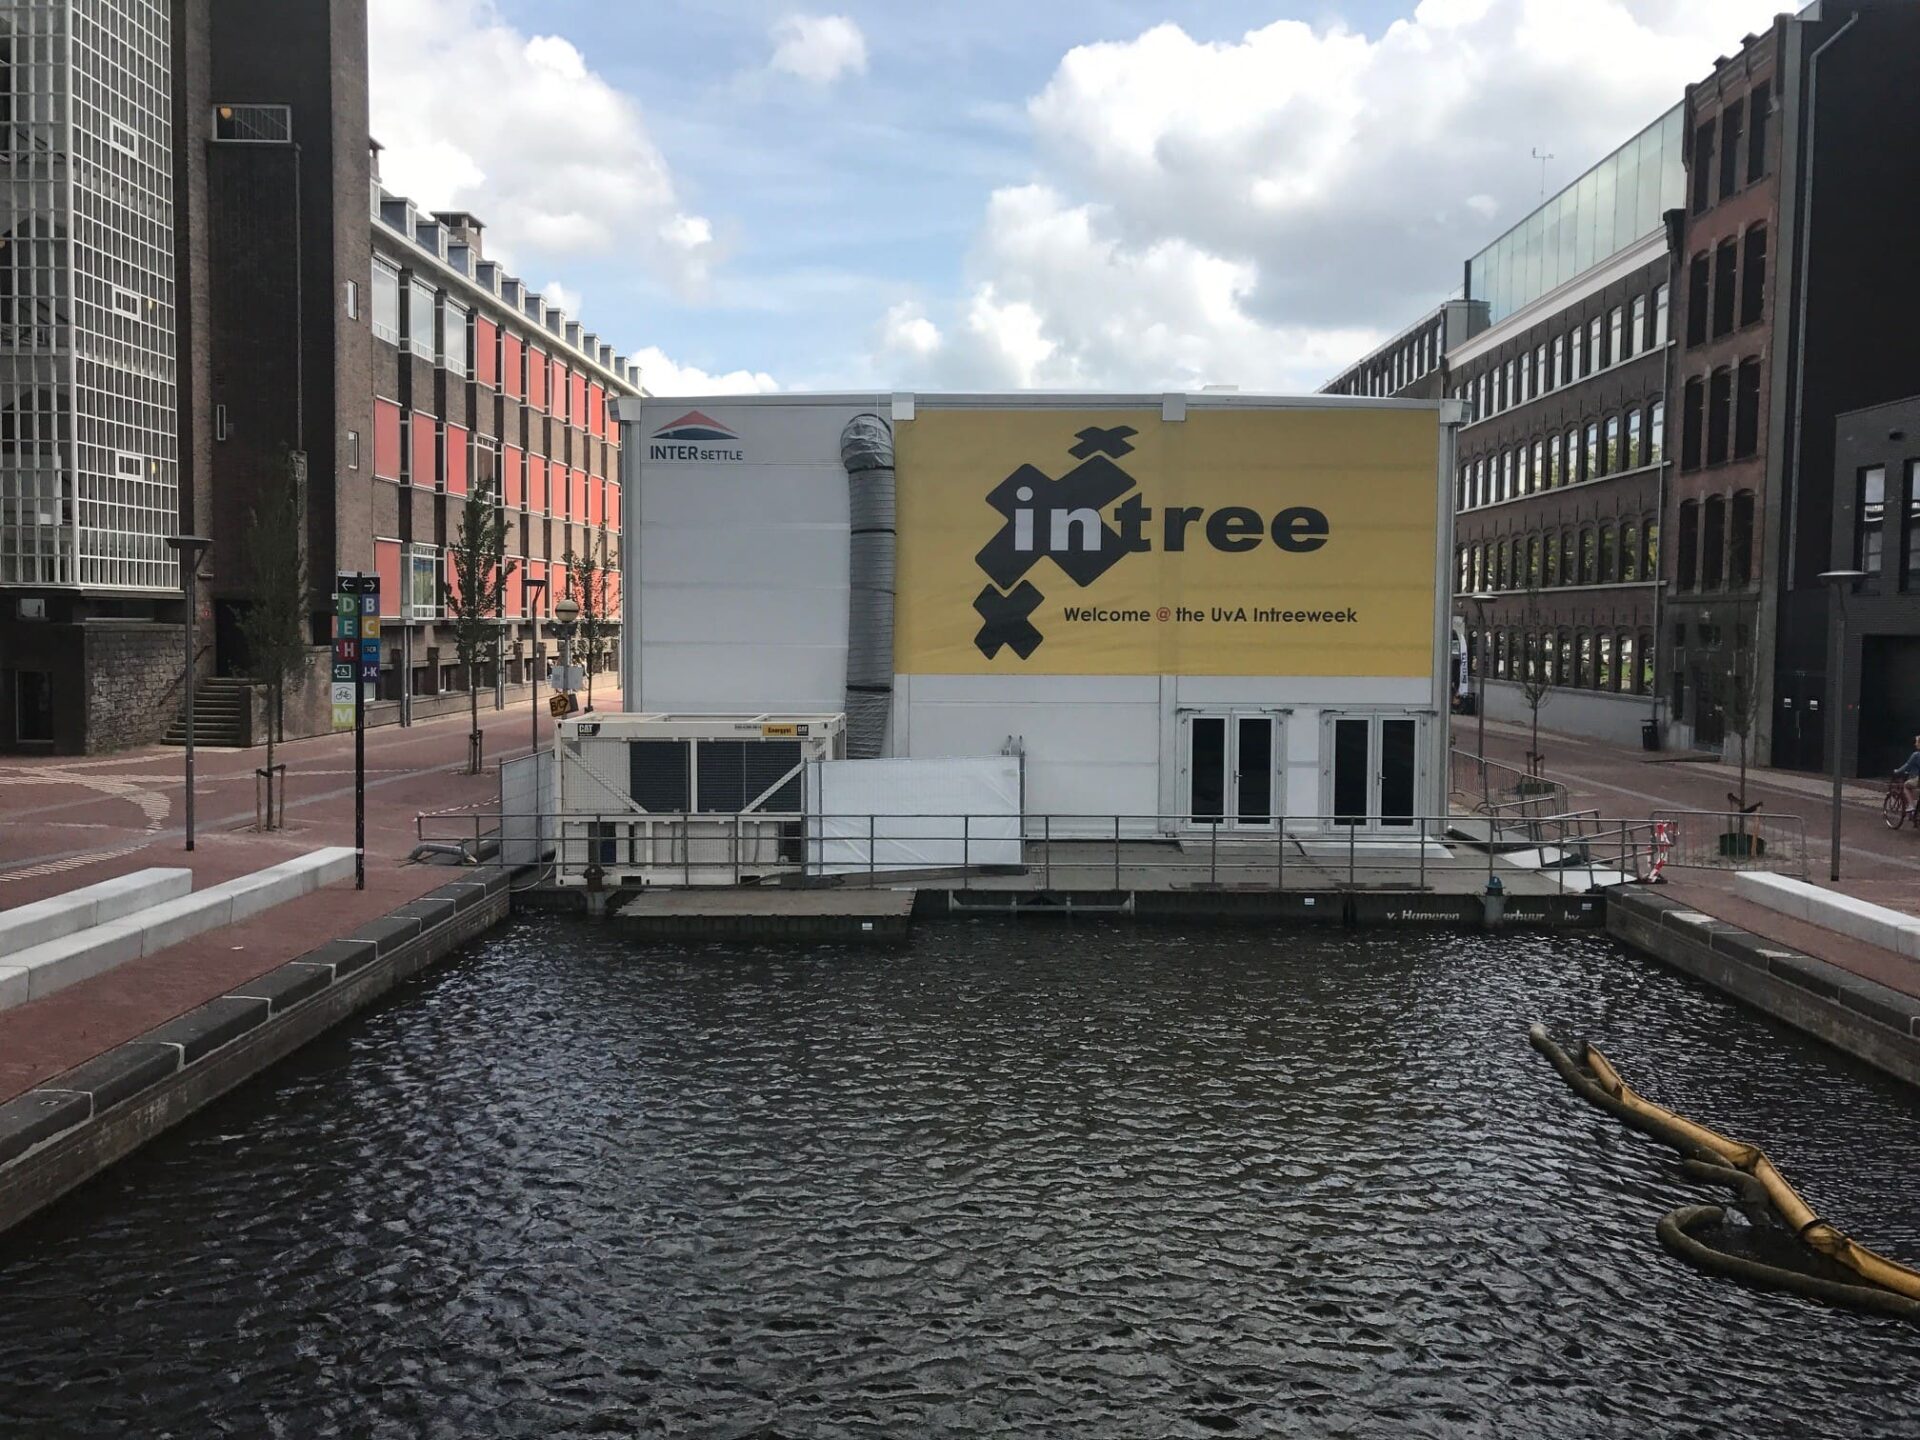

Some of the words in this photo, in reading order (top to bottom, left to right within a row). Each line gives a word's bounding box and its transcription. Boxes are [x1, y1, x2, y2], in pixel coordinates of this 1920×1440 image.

[650, 445, 698, 460] INTER
[700, 450, 743, 460] SETTLE
[1014, 486, 1330, 553] intree
[343, 597, 354, 613] D
[365, 598, 375, 613] B
[1064, 607, 1151, 622] Welcome
[1156, 607, 1171, 622] @
[1176, 607, 1205, 622] the
[1211, 607, 1247, 622] UvA
[1254, 607, 1358, 623] Intreeweek
[344, 620, 353, 635] E
[365, 620, 375, 635] C
[344, 641, 354, 657] H
[362, 666, 377, 677] J-K
[334, 708, 353, 723] M
[580, 725, 592, 733] CAT
